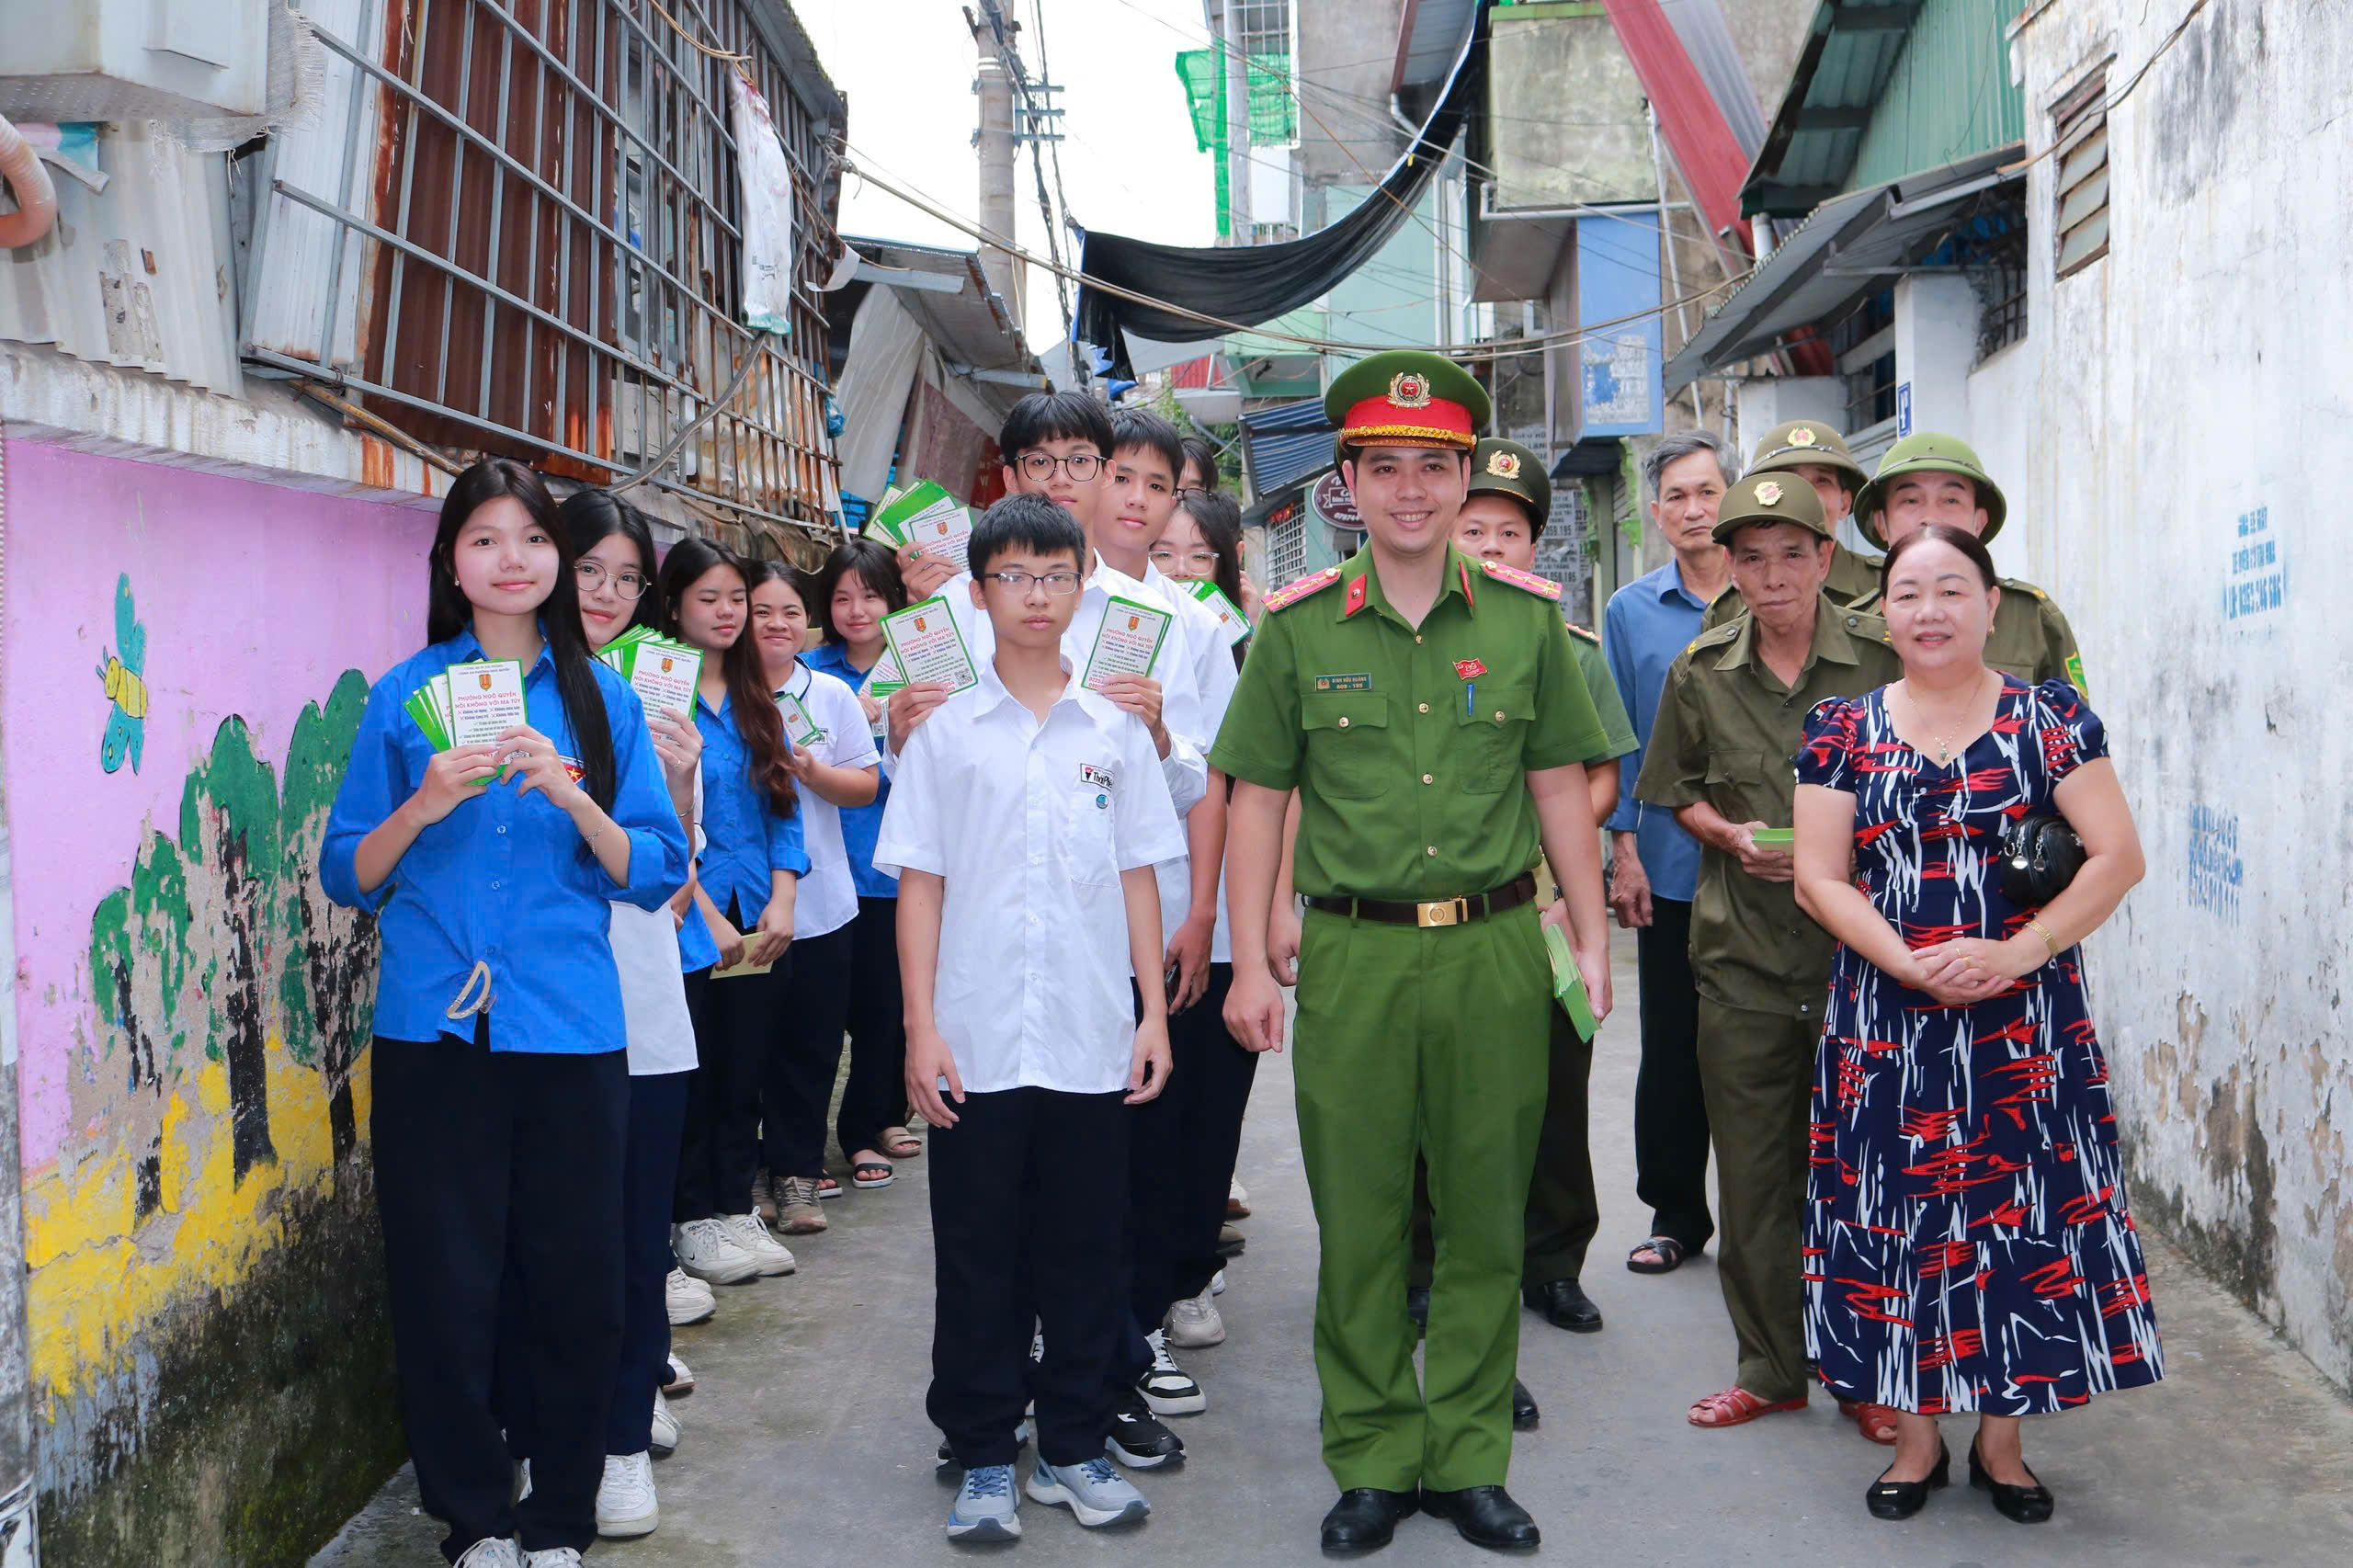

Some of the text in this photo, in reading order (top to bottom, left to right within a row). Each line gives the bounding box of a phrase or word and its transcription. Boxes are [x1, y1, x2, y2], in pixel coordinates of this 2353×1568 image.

[901, 627, 949, 648] PHƯỜNG NGÔ QUYỀN
[910, 641, 927, 651] KHÔNG
[639, 670, 659, 679] PHƯỜNG
[645, 677, 662, 686] KHÔNG
[498, 690, 516, 699] QUYỀN
